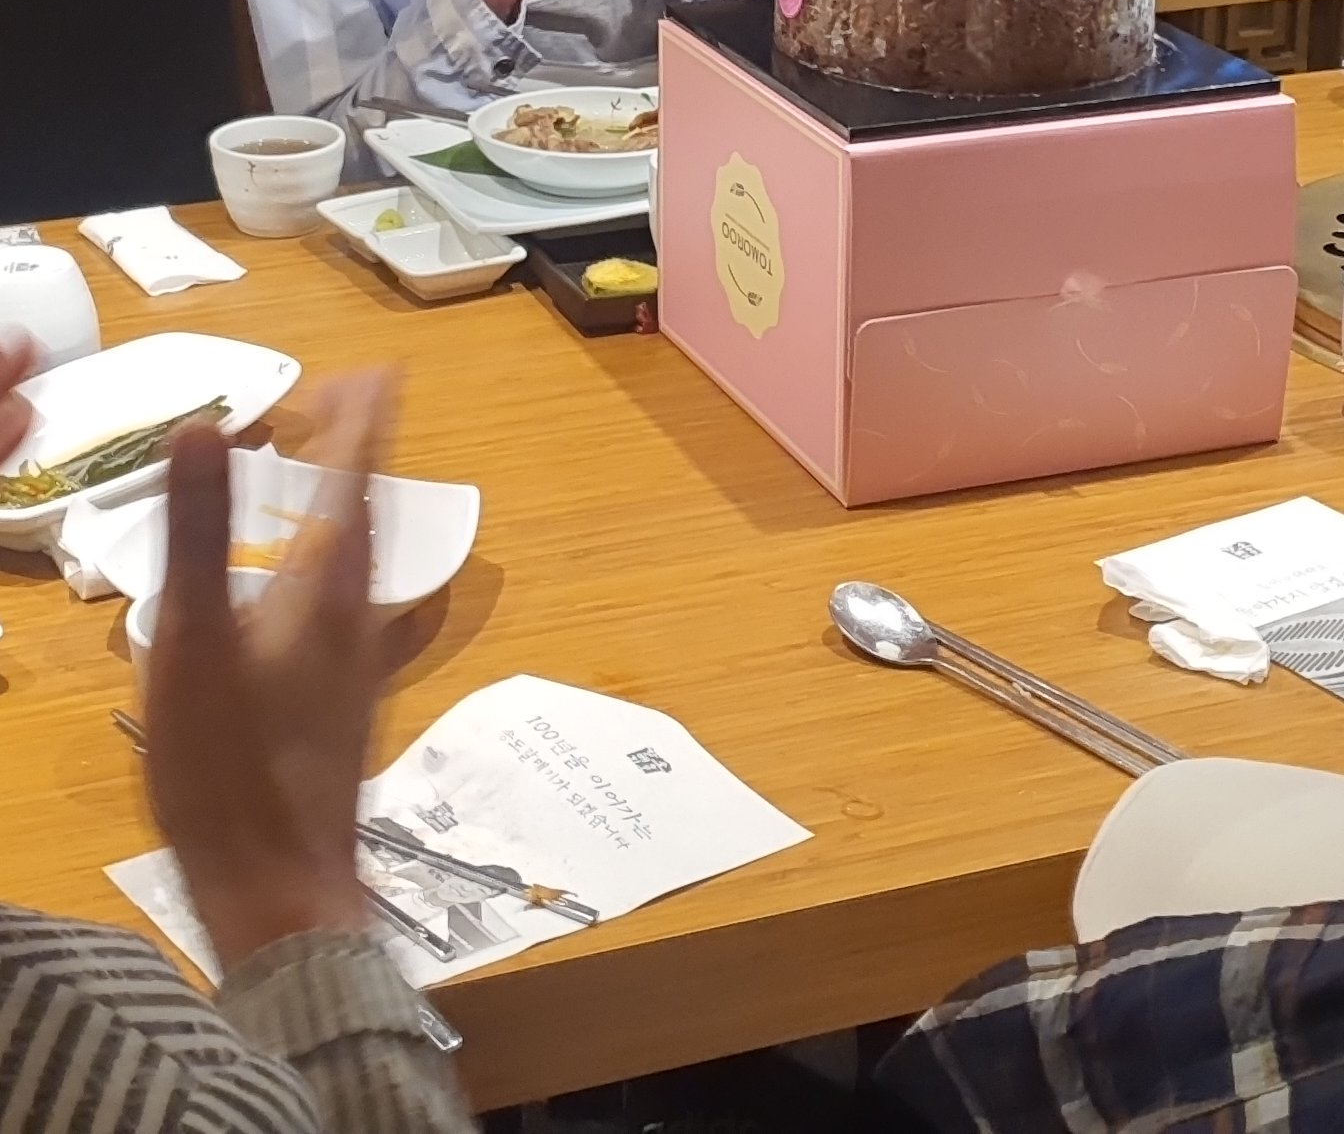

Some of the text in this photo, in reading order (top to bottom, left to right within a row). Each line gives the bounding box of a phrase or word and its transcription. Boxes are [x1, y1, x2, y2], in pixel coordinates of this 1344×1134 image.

[498, 729, 571, 792] 송도갈매기가
[566, 792, 630, 850] 되겠습니다
[524, 715, 591, 770] 100년을
[590, 773, 653, 841] 이어가는
